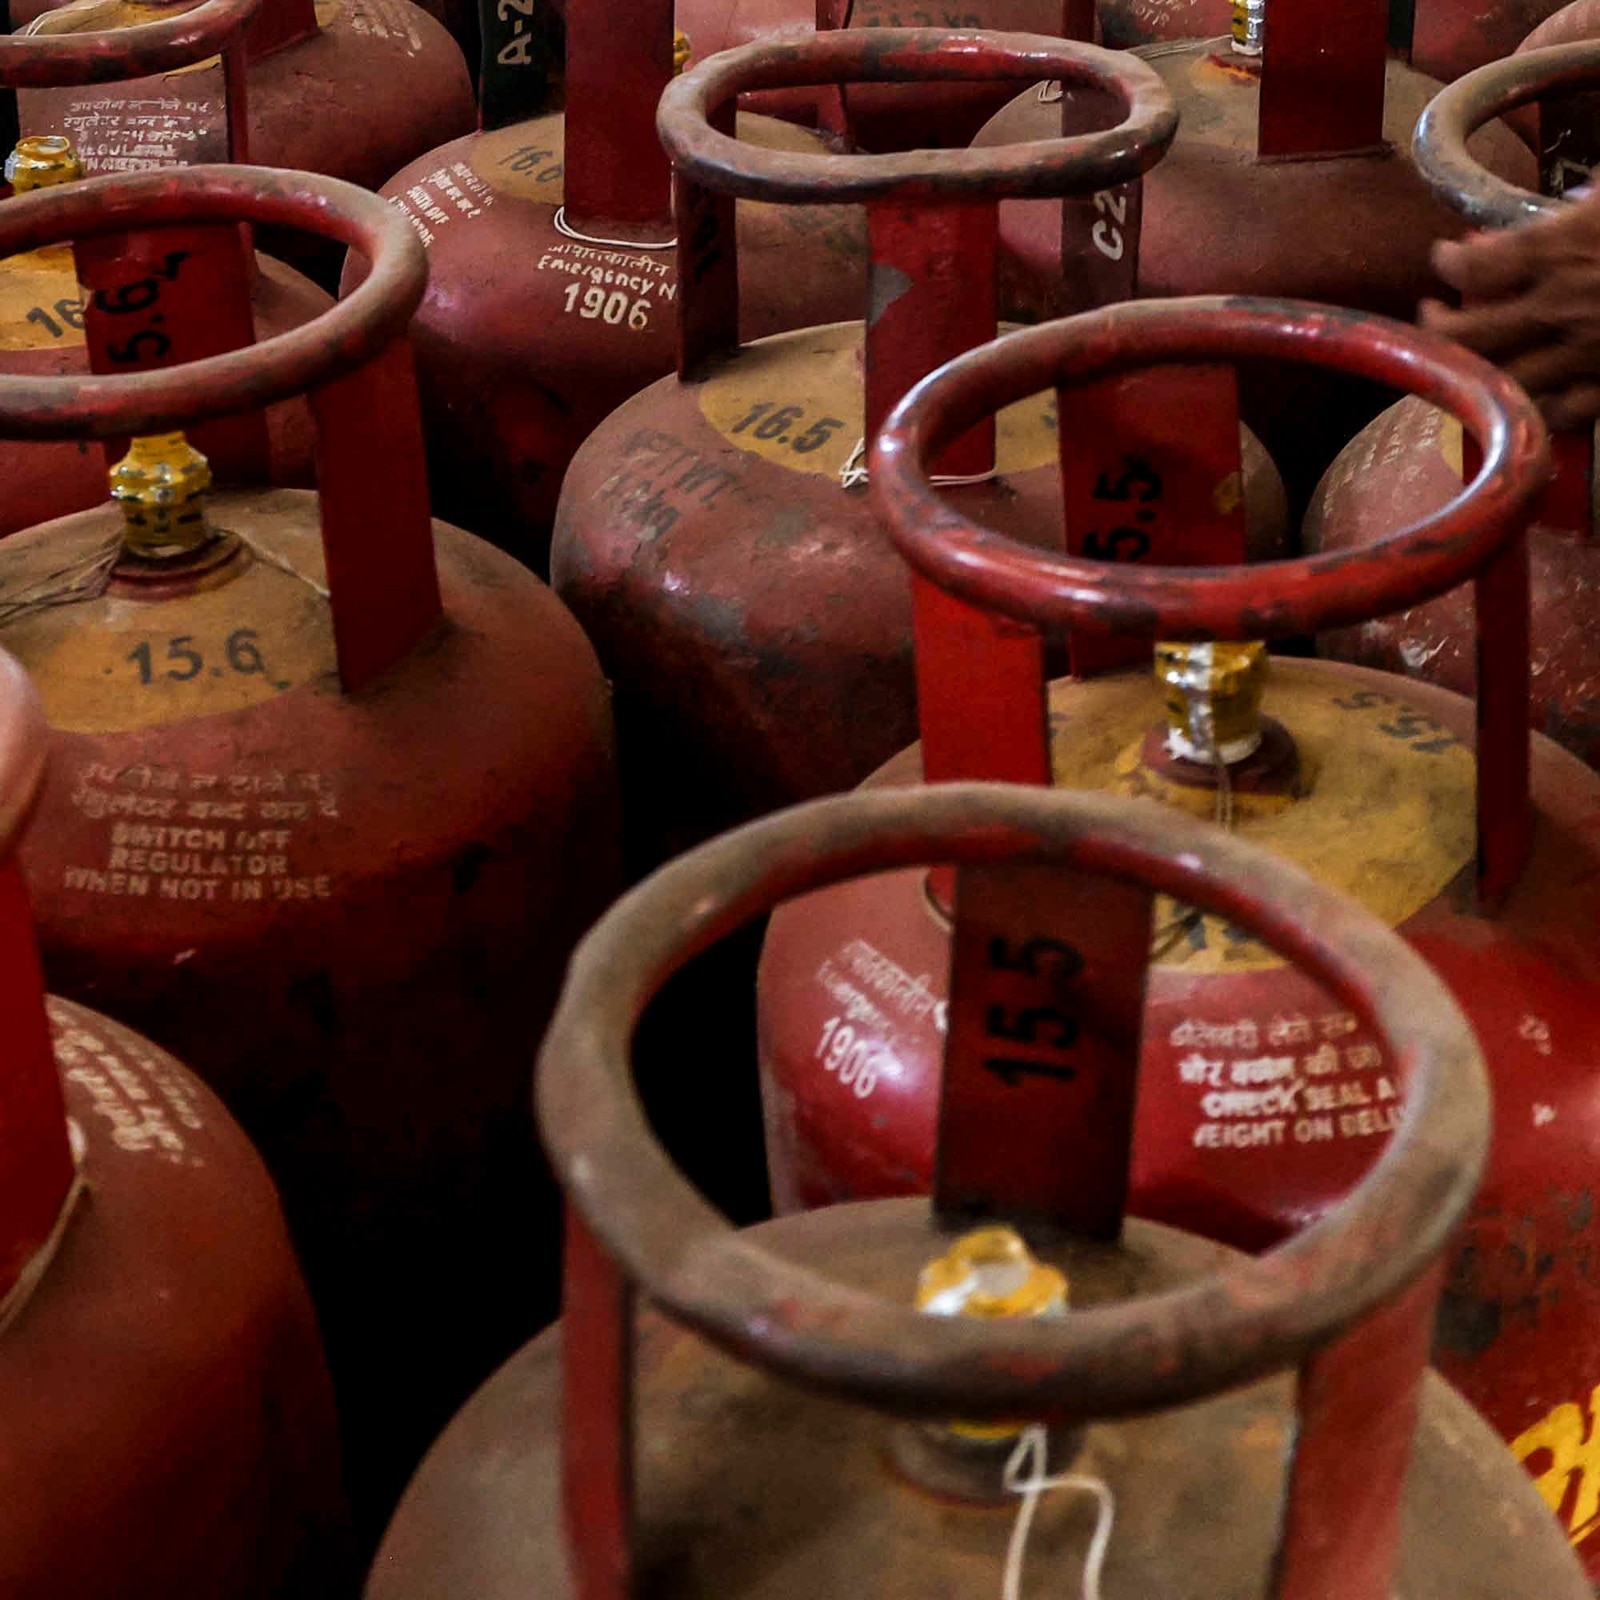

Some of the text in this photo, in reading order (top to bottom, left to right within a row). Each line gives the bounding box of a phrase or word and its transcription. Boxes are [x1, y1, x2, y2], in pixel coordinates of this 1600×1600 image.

[1091, 184, 1128, 261] C2
[95, 275, 172, 364] 5.6
[563, 282, 652, 332] 1906
[658, 283, 678, 301] N
[730, 401, 846, 454] 16.5
[1084, 455, 1163, 561] 5.5
[126, 628, 267, 685] 15.6
[108, 846, 289, 877] REGULATOR
[159, 877, 218, 900] NOT
[814, 1016, 878, 1098] 1906
